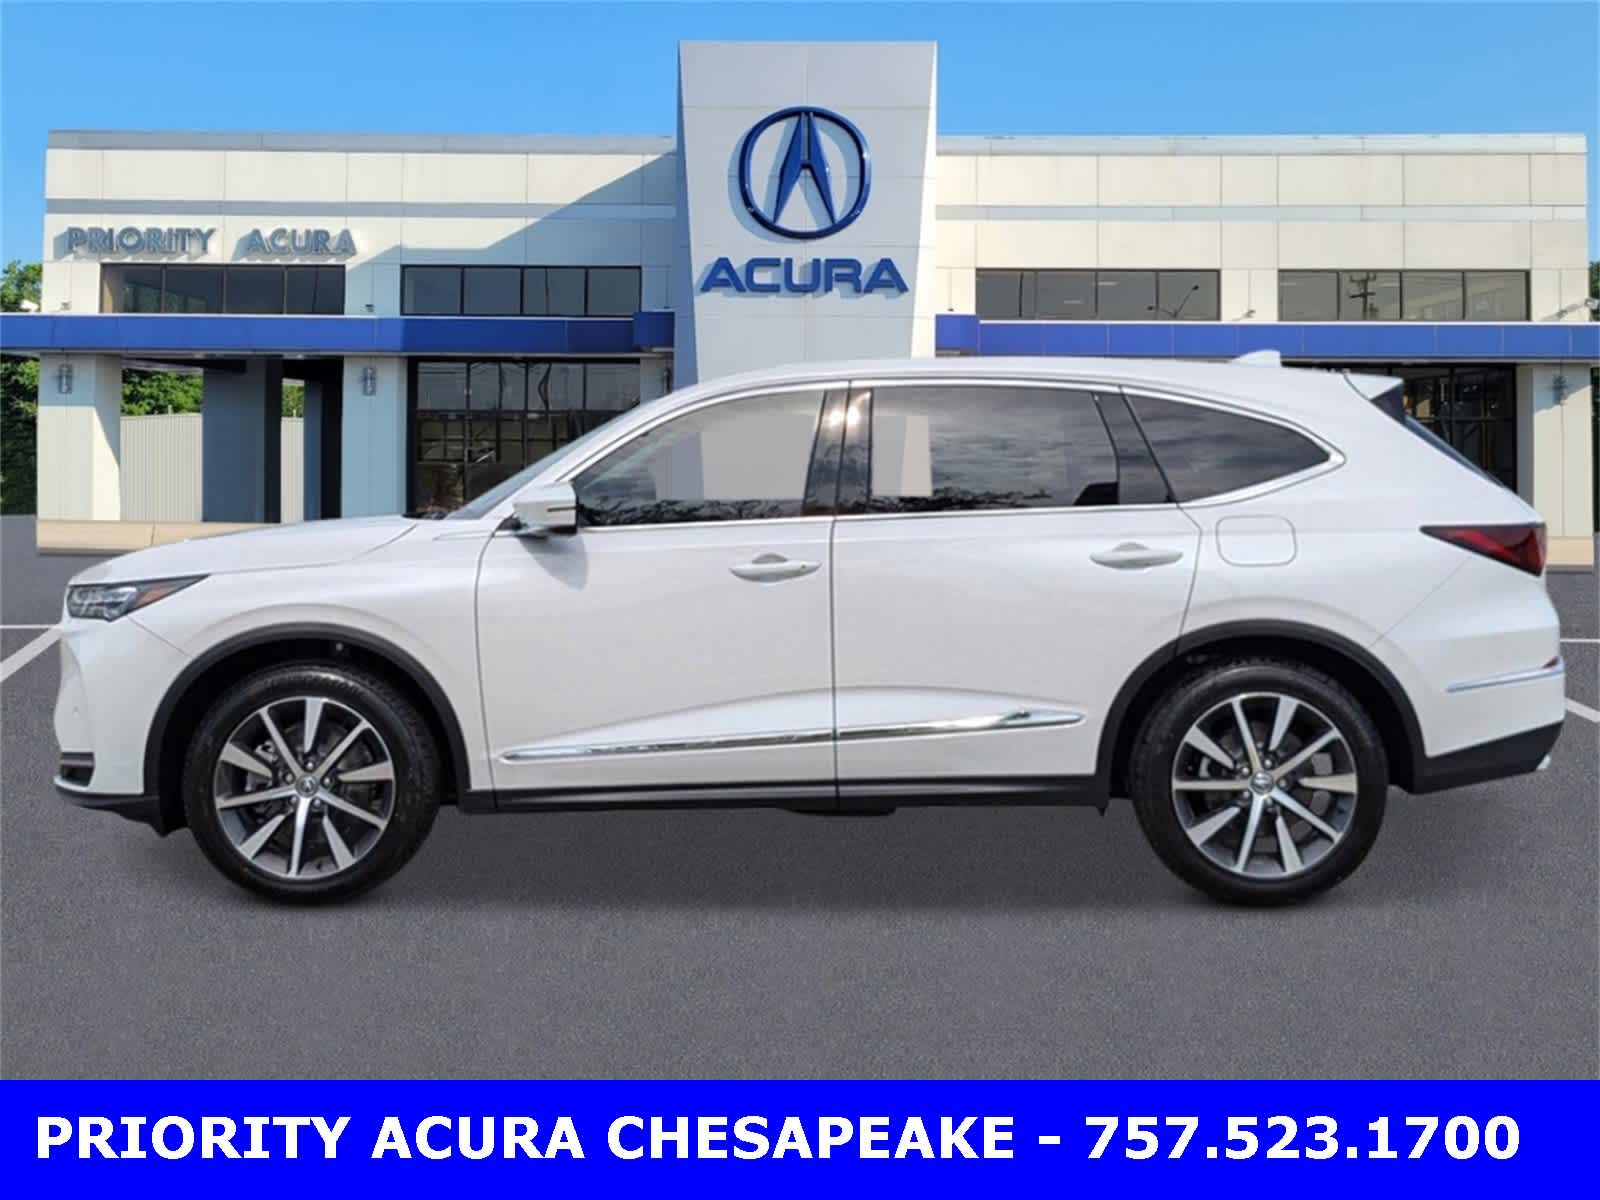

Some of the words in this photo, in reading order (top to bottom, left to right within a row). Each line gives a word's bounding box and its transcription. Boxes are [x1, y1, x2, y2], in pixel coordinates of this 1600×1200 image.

[66, 226, 216, 253] PRIORITY
[246, 227, 357, 257] ACURA
[700, 256, 909, 294] ACURA
